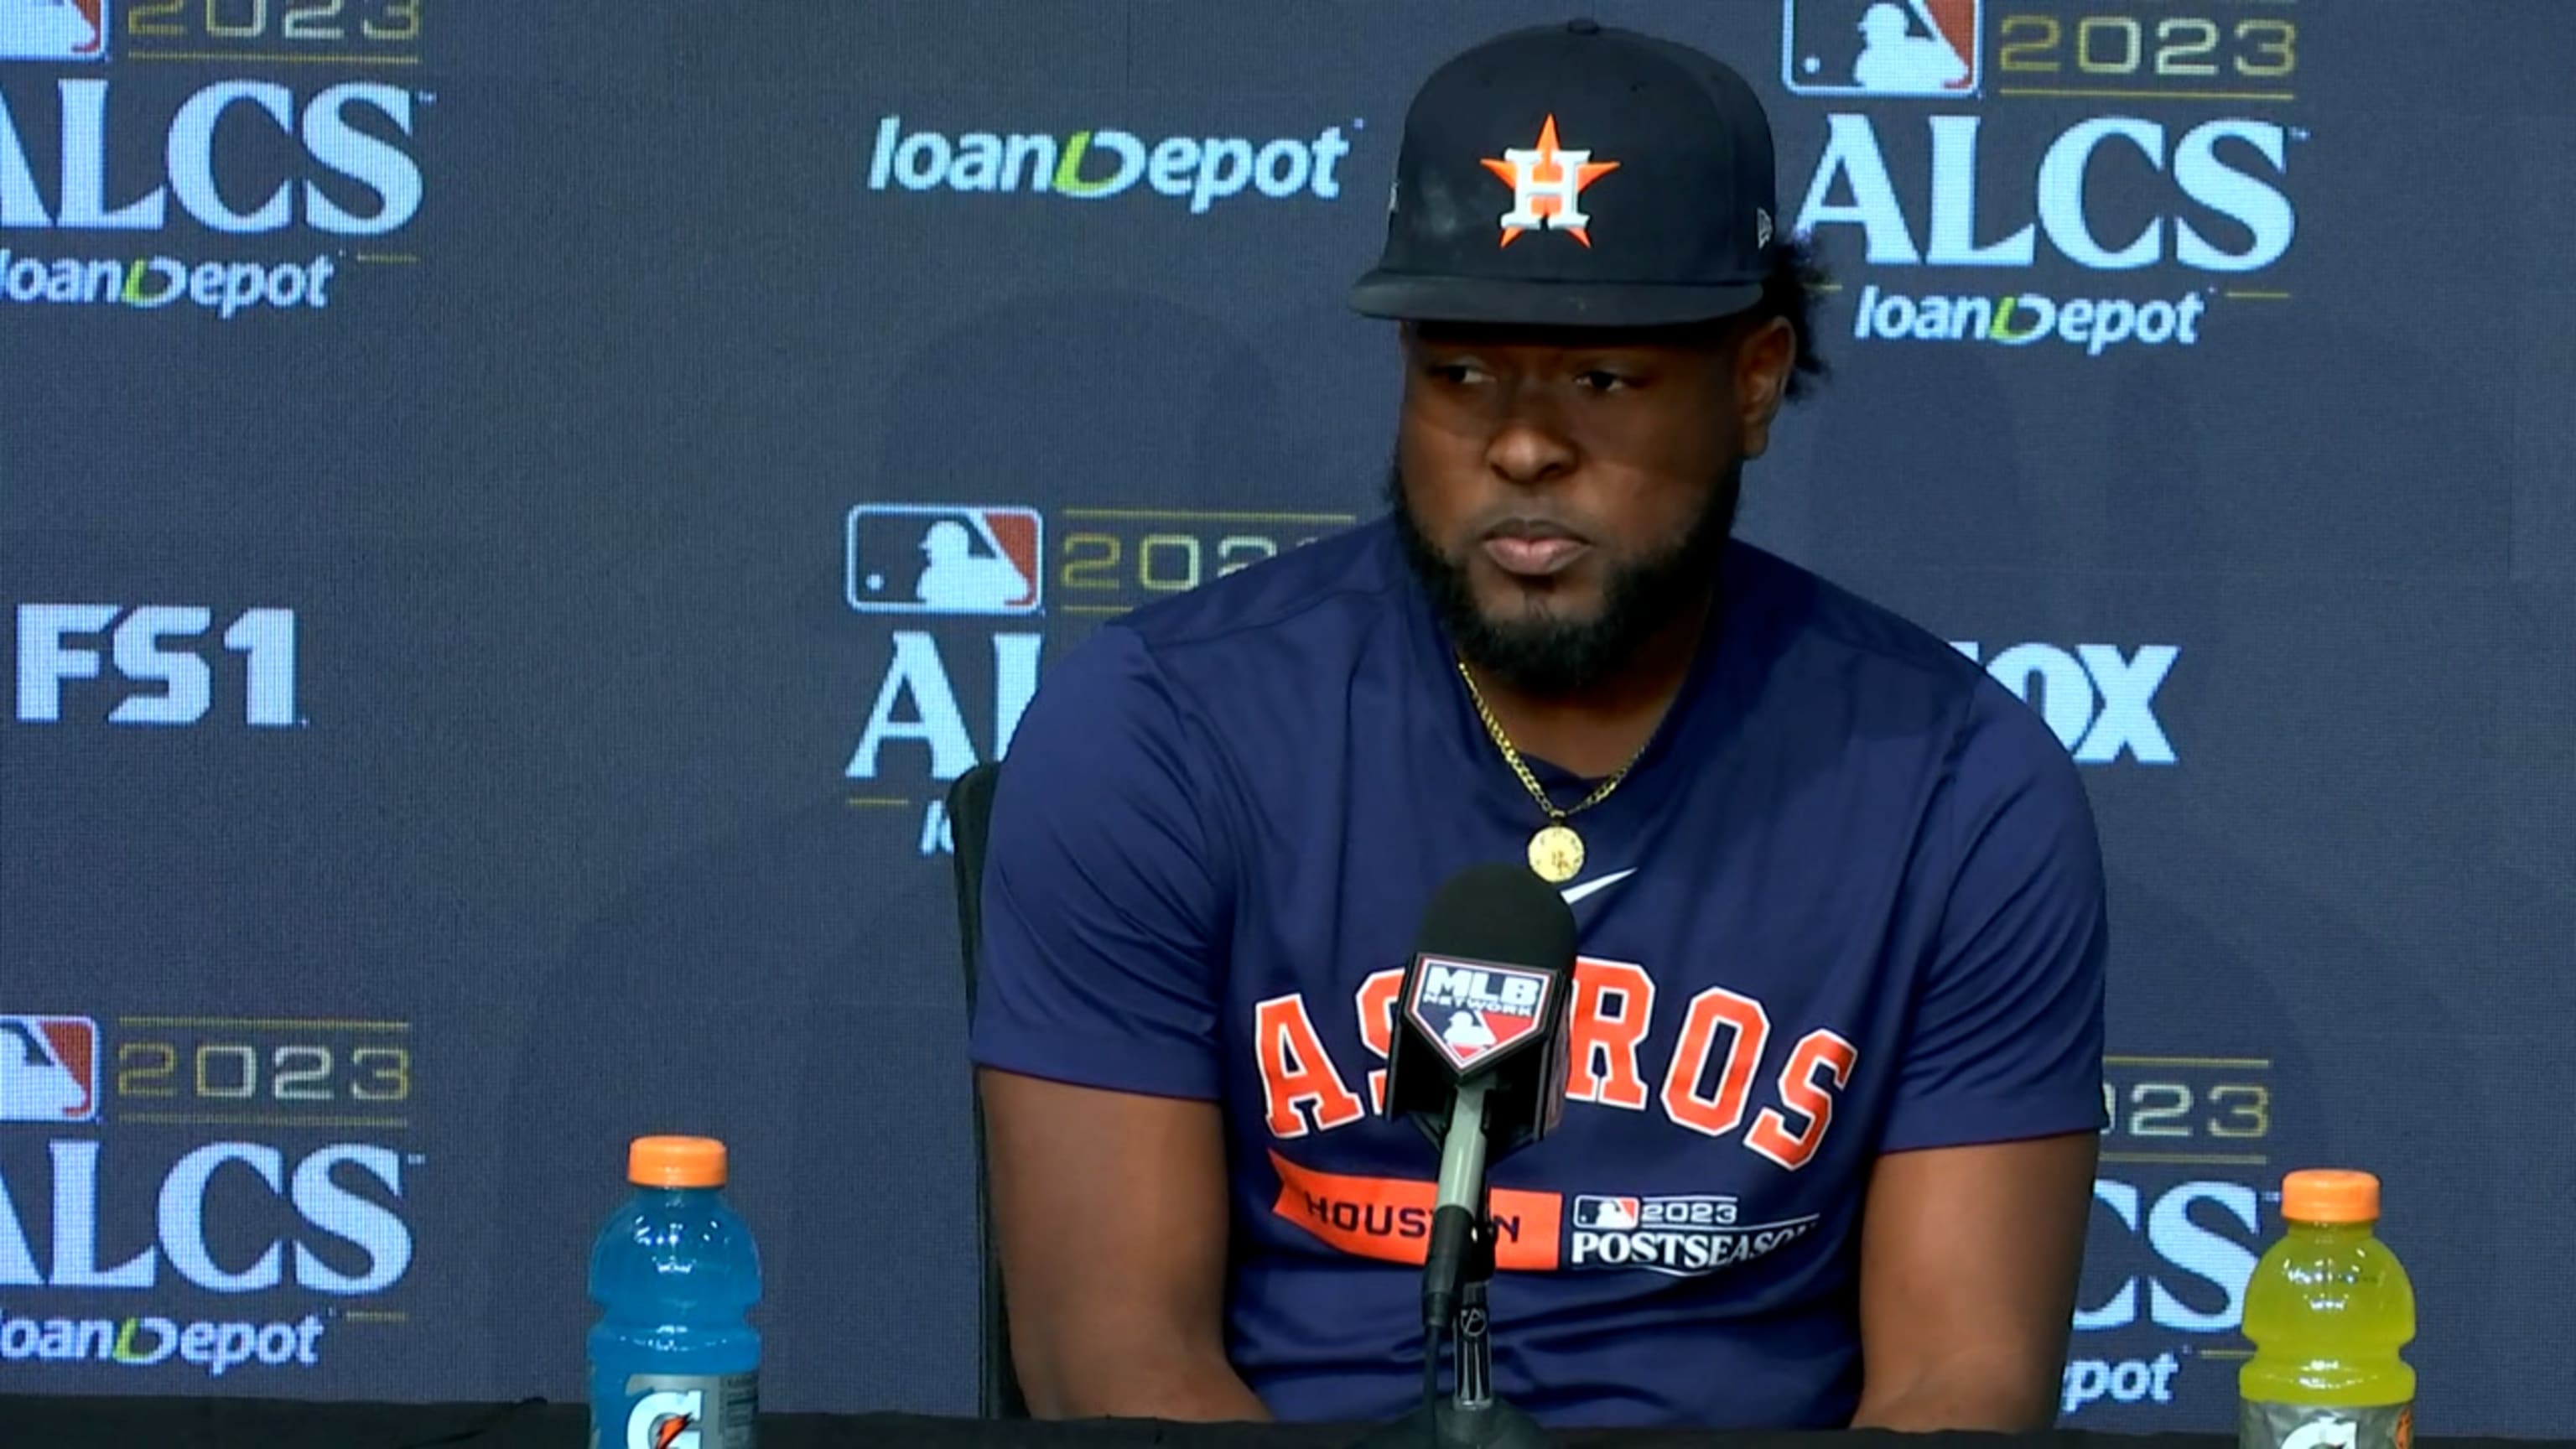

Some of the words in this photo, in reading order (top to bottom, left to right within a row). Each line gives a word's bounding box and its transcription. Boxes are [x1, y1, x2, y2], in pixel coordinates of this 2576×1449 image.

[128, 0, 419, 39] 2023
[1999, 14, 2297, 76] 2023
[867, 115, 1350, 214] loanDepot
[1500, 148, 1592, 230] H
[1793, 113, 2296, 271] ALCS
[1853, 285, 2205, 356] loanDepot
[1059, 532, 1319, 591] 202
[15, 603, 295, 725] FS1
[1947, 641, 2182, 764] OX
[1422, 992, 1534, 1017] NETWORK
[1426, 964, 1540, 1007] MLB
[117, 1043, 411, 1100] 2023
[1256, 955, 1858, 1171] ASROS
[1304, 1191, 1521, 1244] HOUSN
[1642, 1202, 1737, 1224] 2023
[0, 1310, 325, 1378] oanDepot
